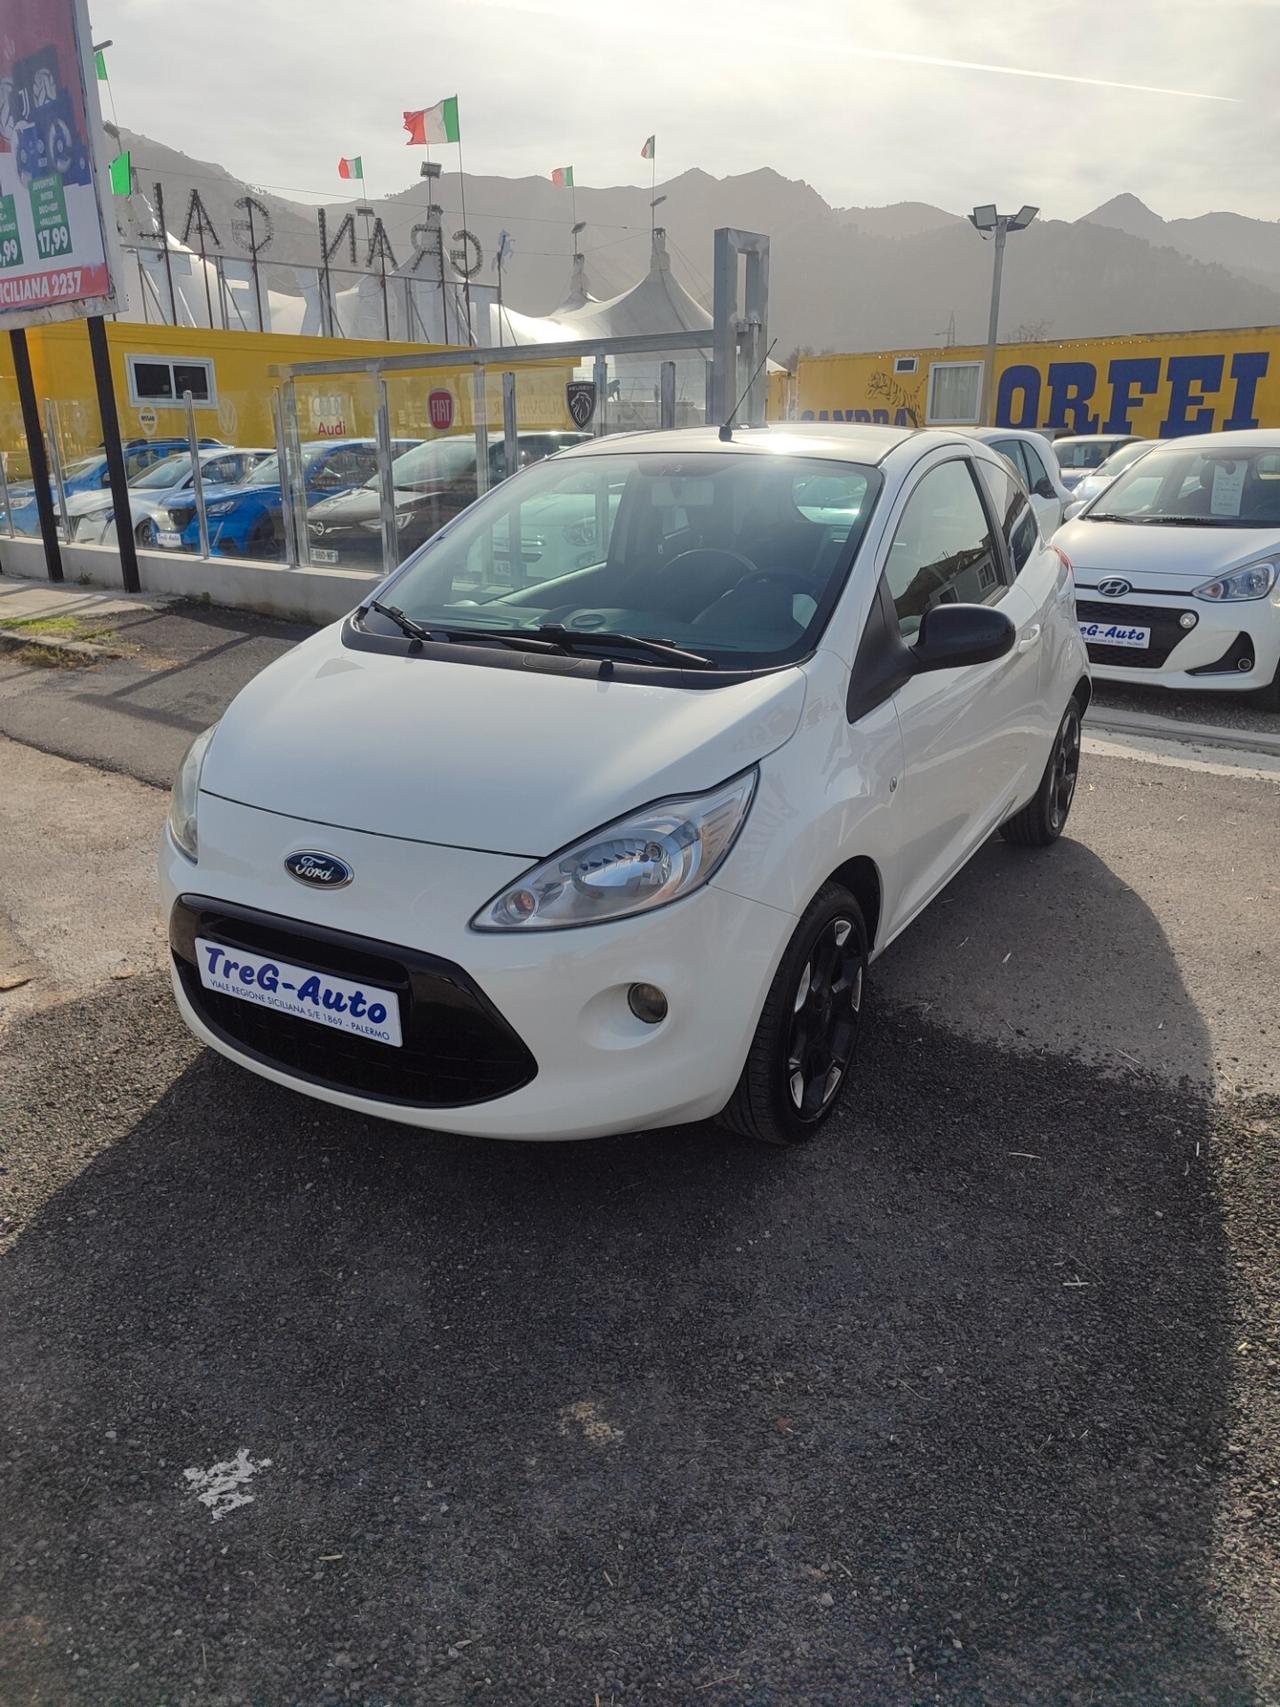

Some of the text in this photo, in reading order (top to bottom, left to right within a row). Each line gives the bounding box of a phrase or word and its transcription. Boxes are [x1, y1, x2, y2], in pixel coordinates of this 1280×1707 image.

[38, 226, 68, 255] 17,99
[51, 270, 82, 297] 2237
[995, 352, 1270, 438] ORFEI
[431, 400, 450, 422] FIAT
[318, 421, 346, 436] Audi
[295, 855, 334, 881] Ford
[205, 946, 387, 1024] TreG-Auto
[209, 979, 231, 992] VIALE
[231, 985, 266, 1003] REGIONE
[267, 996, 306, 1015] SICILIANA
[323, 1013, 343, 1026] 1869
[351, 1022, 390, 1041] PALERMO
